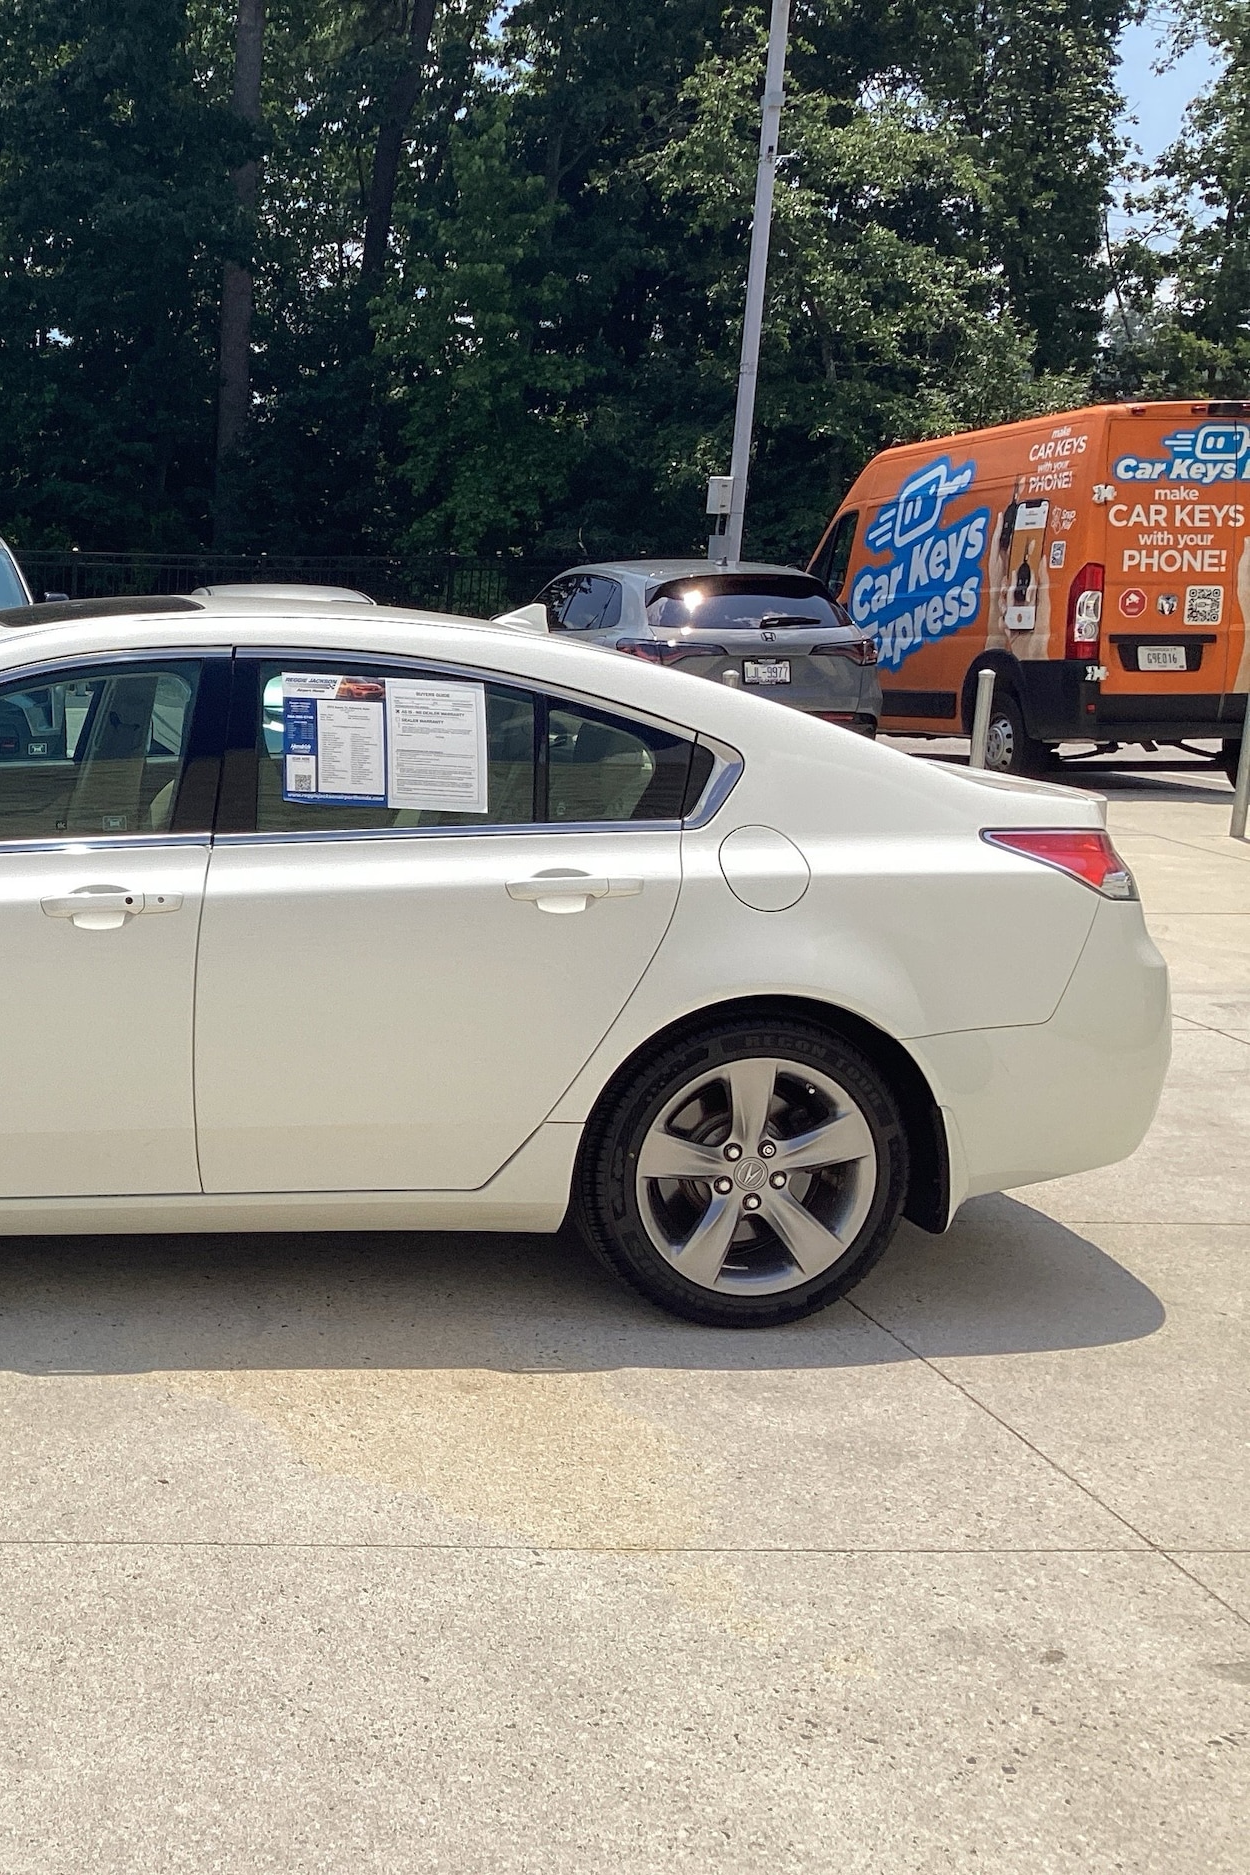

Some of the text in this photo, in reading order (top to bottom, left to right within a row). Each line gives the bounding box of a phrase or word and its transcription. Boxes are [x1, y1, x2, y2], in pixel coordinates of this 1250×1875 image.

[1052, 426, 1071, 439] make
[1029, 435, 1088, 461] CAR KEYS
[1038, 460, 1070, 473] with your
[1116, 458, 1166, 479] Car
[1169, 459, 1236, 483] Keys
[1028, 471, 1073, 493] PHONE!
[1154, 486, 1199, 500] make
[1108, 504, 1245, 527] CAR KEYS
[1138, 532, 1214, 548] with your
[852, 517, 986, 621] Car Keys
[1122, 550, 1227, 573] PHONE!
[746, 667, 788, 678] LJL-9977
